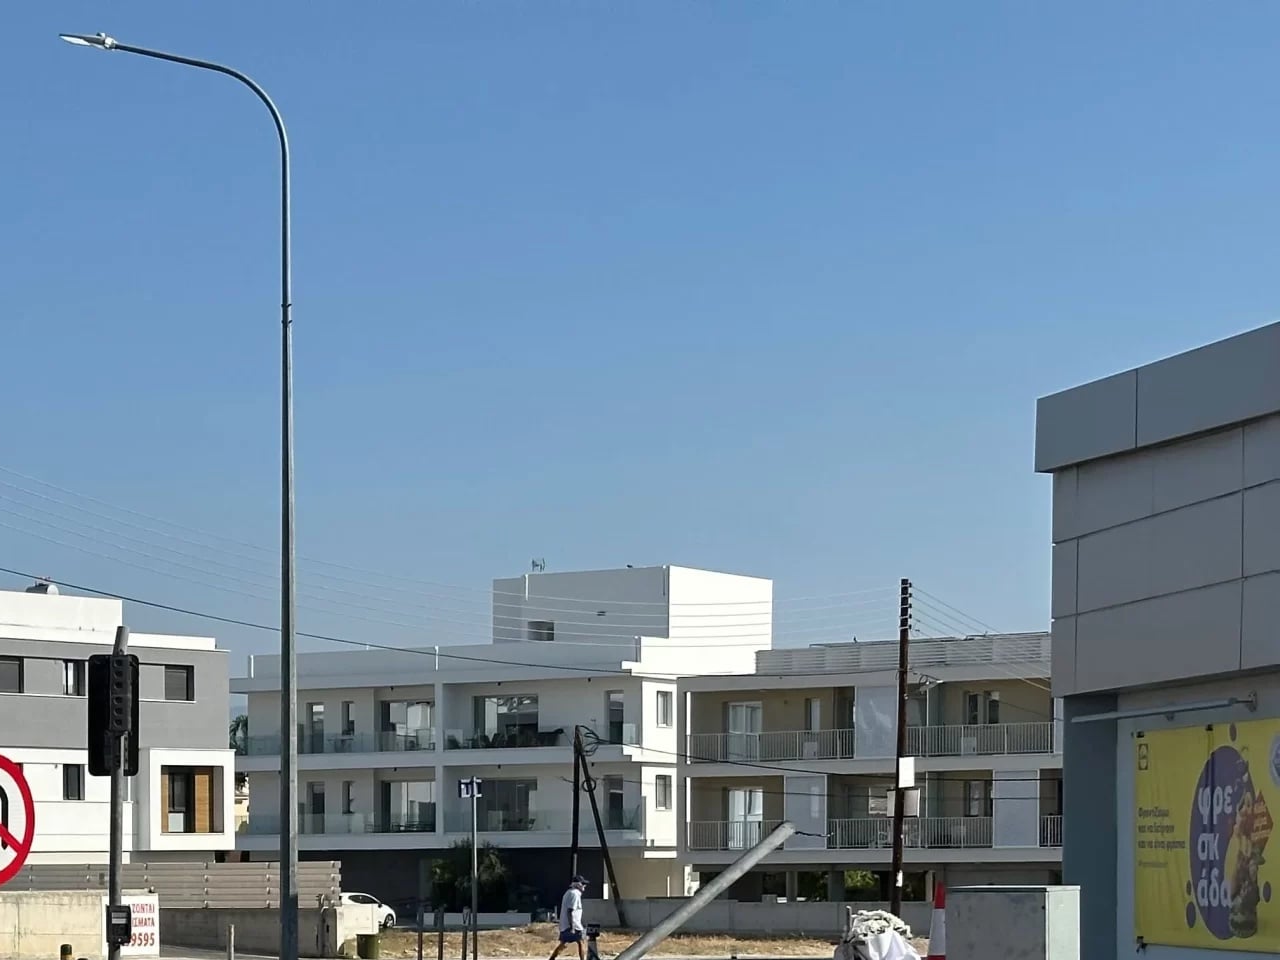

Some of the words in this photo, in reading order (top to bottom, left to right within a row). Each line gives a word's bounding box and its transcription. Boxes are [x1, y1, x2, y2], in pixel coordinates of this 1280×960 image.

[1197, 833, 1219, 861] σκ
[132, 904, 155, 913] ΖΟΝΤΑΙ
[131, 933, 155, 947] 9595
